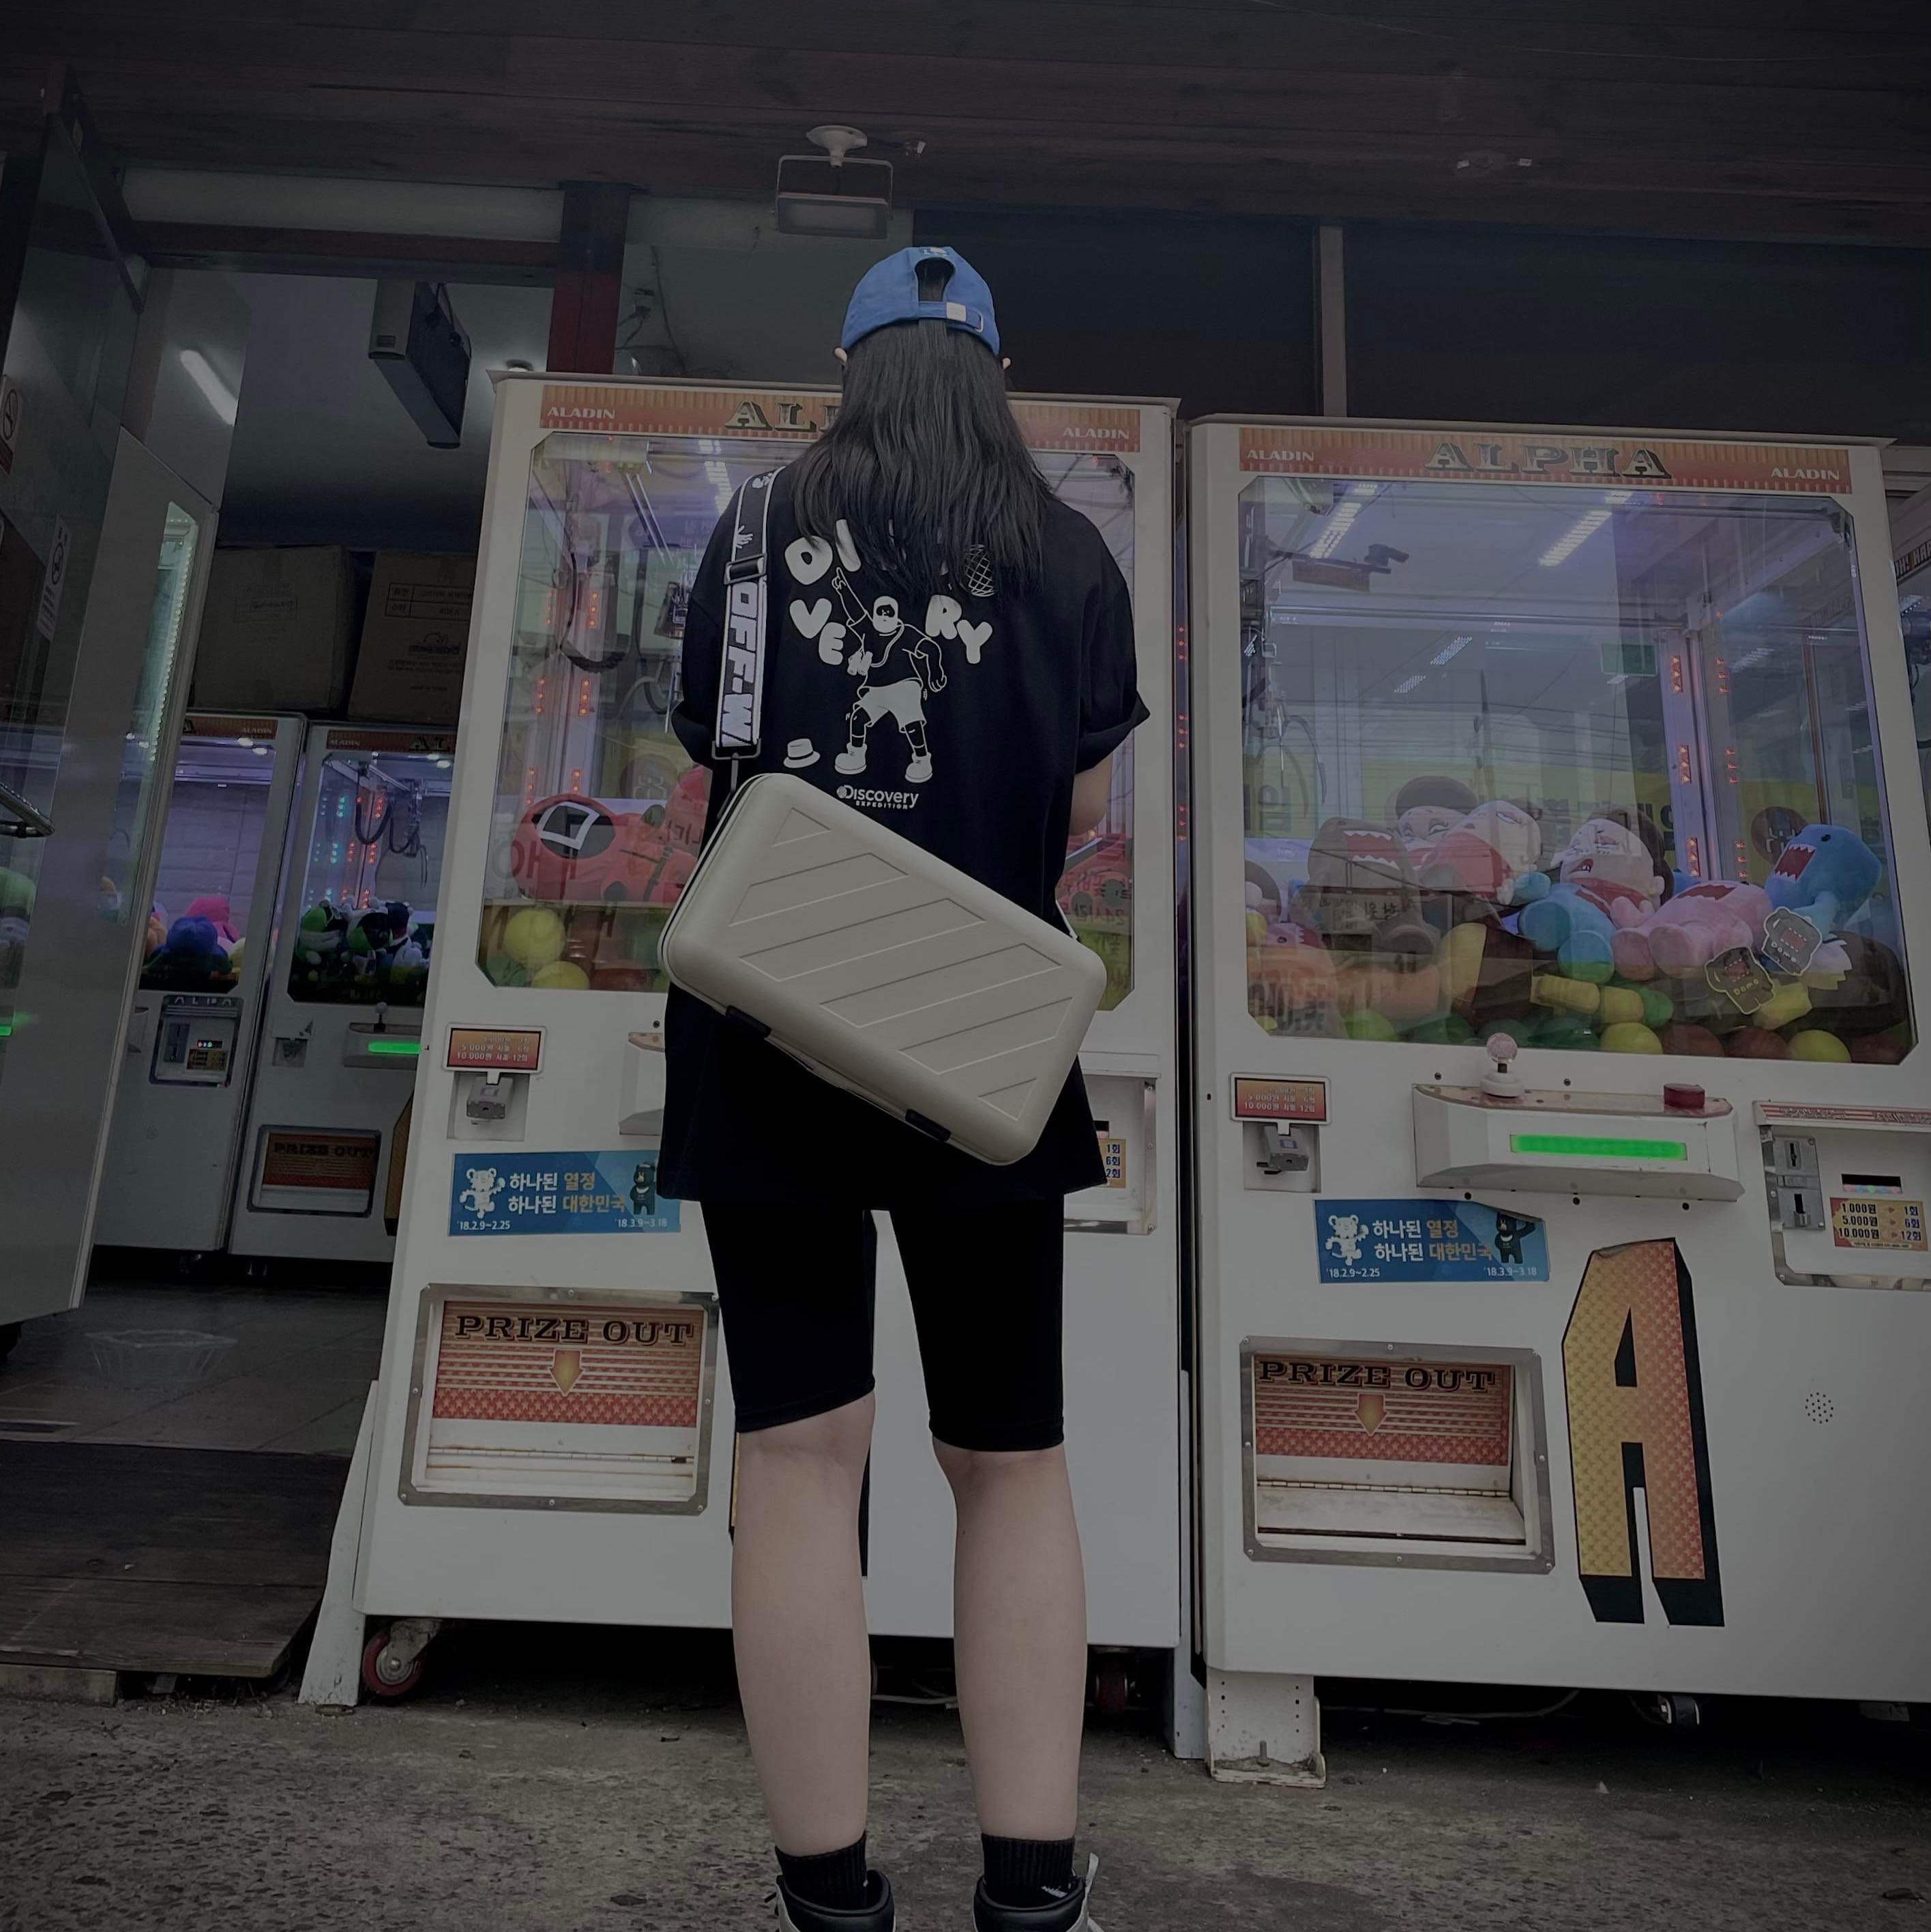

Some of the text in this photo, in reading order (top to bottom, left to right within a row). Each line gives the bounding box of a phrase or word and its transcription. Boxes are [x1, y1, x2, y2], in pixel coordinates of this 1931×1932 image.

[548, 407, 615, 420] ALADIN
[1063, 427, 1130, 441] ALADIN
[1247, 450, 1314, 463] ALADIN
[1424, 443, 1672, 479] ALPHA
[1771, 467, 1840, 481] ALADIN
[855, 800, 908, 810] EXPEDITION
[1771, 941, 1797, 963] Domo
[1733, 979, 1759, 996] Domo
[1106, 1156, 1120, 1165] 6회
[509, 1171, 595, 1192] 하나된 열정
[508, 1194, 625, 1215] 하나된 대한민국
[1372, 1219, 1458, 1239] 하나된 열정
[1374, 1242, 1493, 1262] 하나된 대한민국
[455, 1315, 694, 1347] PRIZE OUT
[1258, 1360, 1495, 1392] PRIZE OUT
[1562, 1238, 1724, 1626] A
